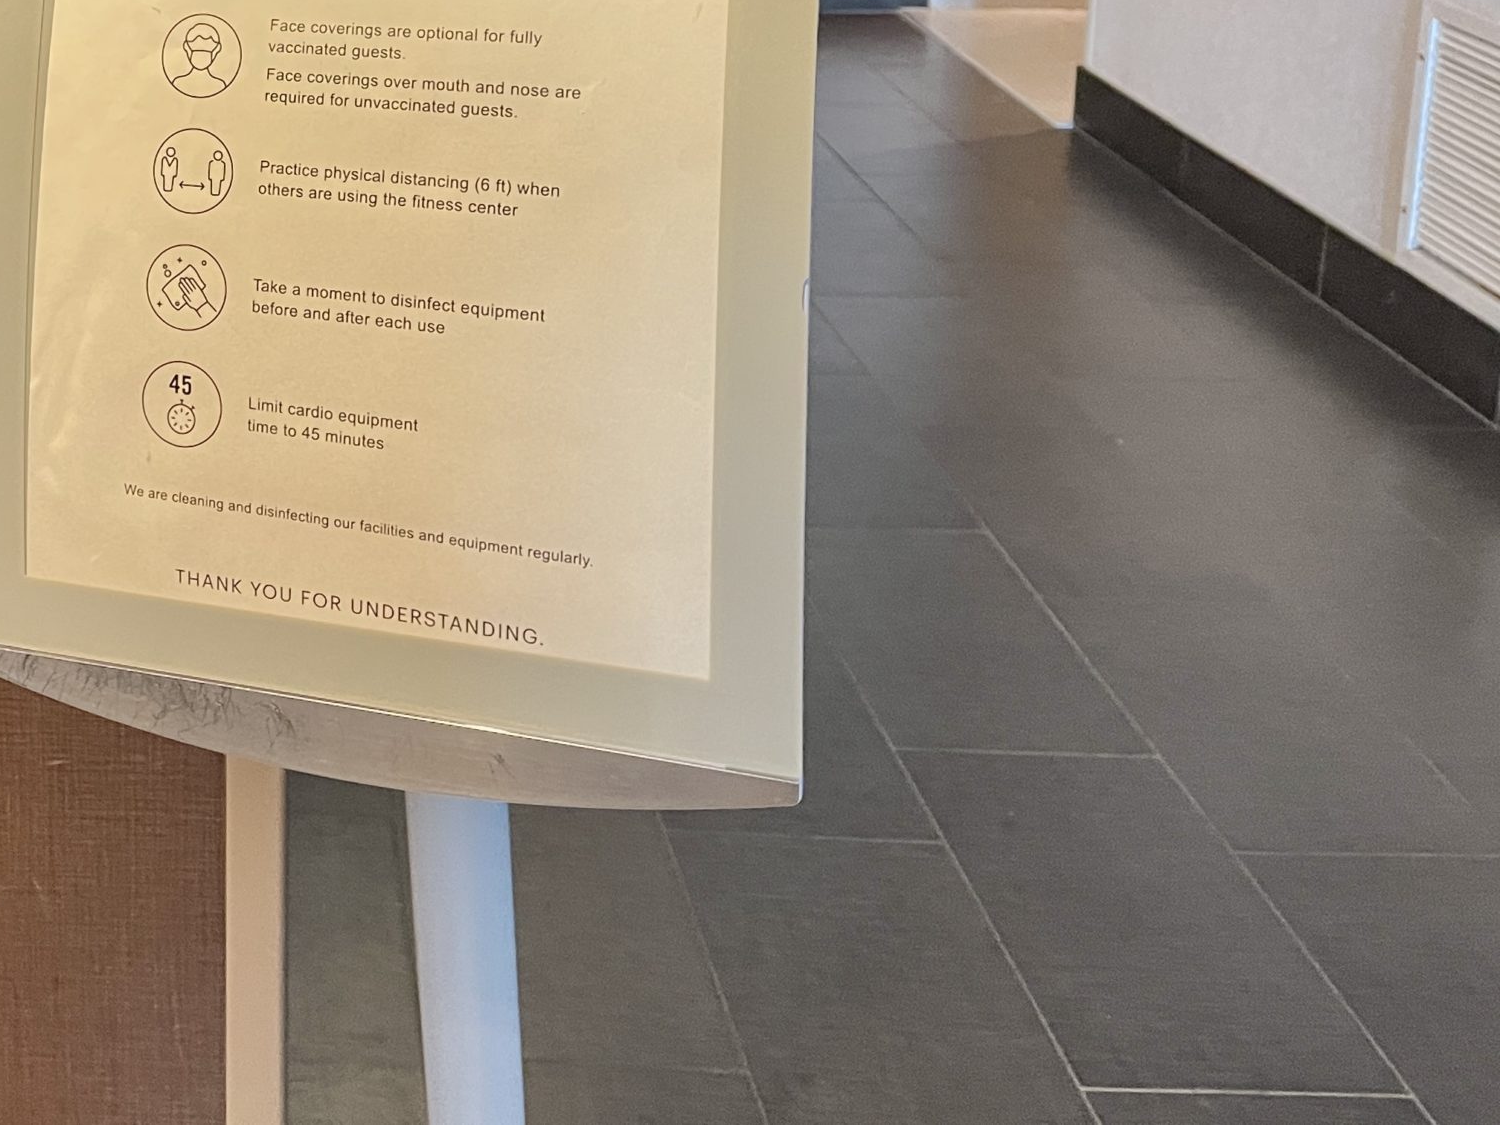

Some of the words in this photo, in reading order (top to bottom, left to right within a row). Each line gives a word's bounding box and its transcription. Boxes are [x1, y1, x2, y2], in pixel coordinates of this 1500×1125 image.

[271, 19, 305, 32] Face
[311, 24, 381, 39] coverings
[388, 28, 411, 38] are
[417, 27, 477, 41] optional
[484, 29, 504, 42] for
[511, 30, 542, 47] fully
[269, 43, 346, 56] vaccinated
[352, 47, 406, 60] guests.
[267, 68, 301, 82] Face
[307, 74, 378, 89] coverings
[384, 78, 417, 89] over
[422, 79, 469, 92] mouth
[476, 82, 504, 94] and
[511, 86, 549, 97] nose
[555, 88, 580, 99] are
[265, 93, 324, 108] required
[331, 93, 349, 106] for
[355, 98, 455, 113] unvaccinated
[461, 105, 518, 118] guests.
[260, 160, 318, 177] Practice
[324, 166, 385, 183] physical
[391, 171, 468, 193] distancing
[475, 178, 489, 194] (6
[496, 179, 511, 196] ft)
[517, 182, 559, 197] when
[259, 183, 303, 197] others
[309, 189, 332, 200] are
[338, 192, 377, 207] using
[384, 193, 406, 206] the
[413, 195, 462, 211] fitness
[469, 203, 518, 216] center
[254, 278, 286, 294] Take
[292, 286, 300, 295] a
[307, 288, 366, 303] moment
[372, 292, 385, 304] to
[391, 294, 455, 312] disinfect
[461, 304, 544, 322] equipment
[253, 300, 297, 317] before
[303, 309, 330, 321] and
[336, 311, 370, 325] after
[375, 317, 411, 330] each
[418, 322, 444, 334] use
[169, 374, 191, 395] 45
[249, 397, 282, 413] Limit
[288, 406, 333, 420] cardio
[339, 412, 417, 431] equipment
[248, 419, 277, 434] time
[284, 425, 296, 437] to
[302, 427, 319, 440] 45
[326, 431, 384, 449] minutes
[124, 484, 144, 497] We
[148, 490, 167, 500] are
[172, 492, 223, 512] cleaning
[228, 503, 251, 513] and
[256, 505, 329, 528] disinfecting
[334, 519, 355, 529] our
[360, 520, 414, 538] facilities
[419, 532, 443, 543] and
[449, 537, 522, 556] equipment
[528, 549, 594, 569] regularly.
[176, 569, 241, 594] THANK
[251, 582, 291, 602] YOU
[302, 591, 340, 611] FOR
[351, 599, 543, 645] UNDERSTANDING.
